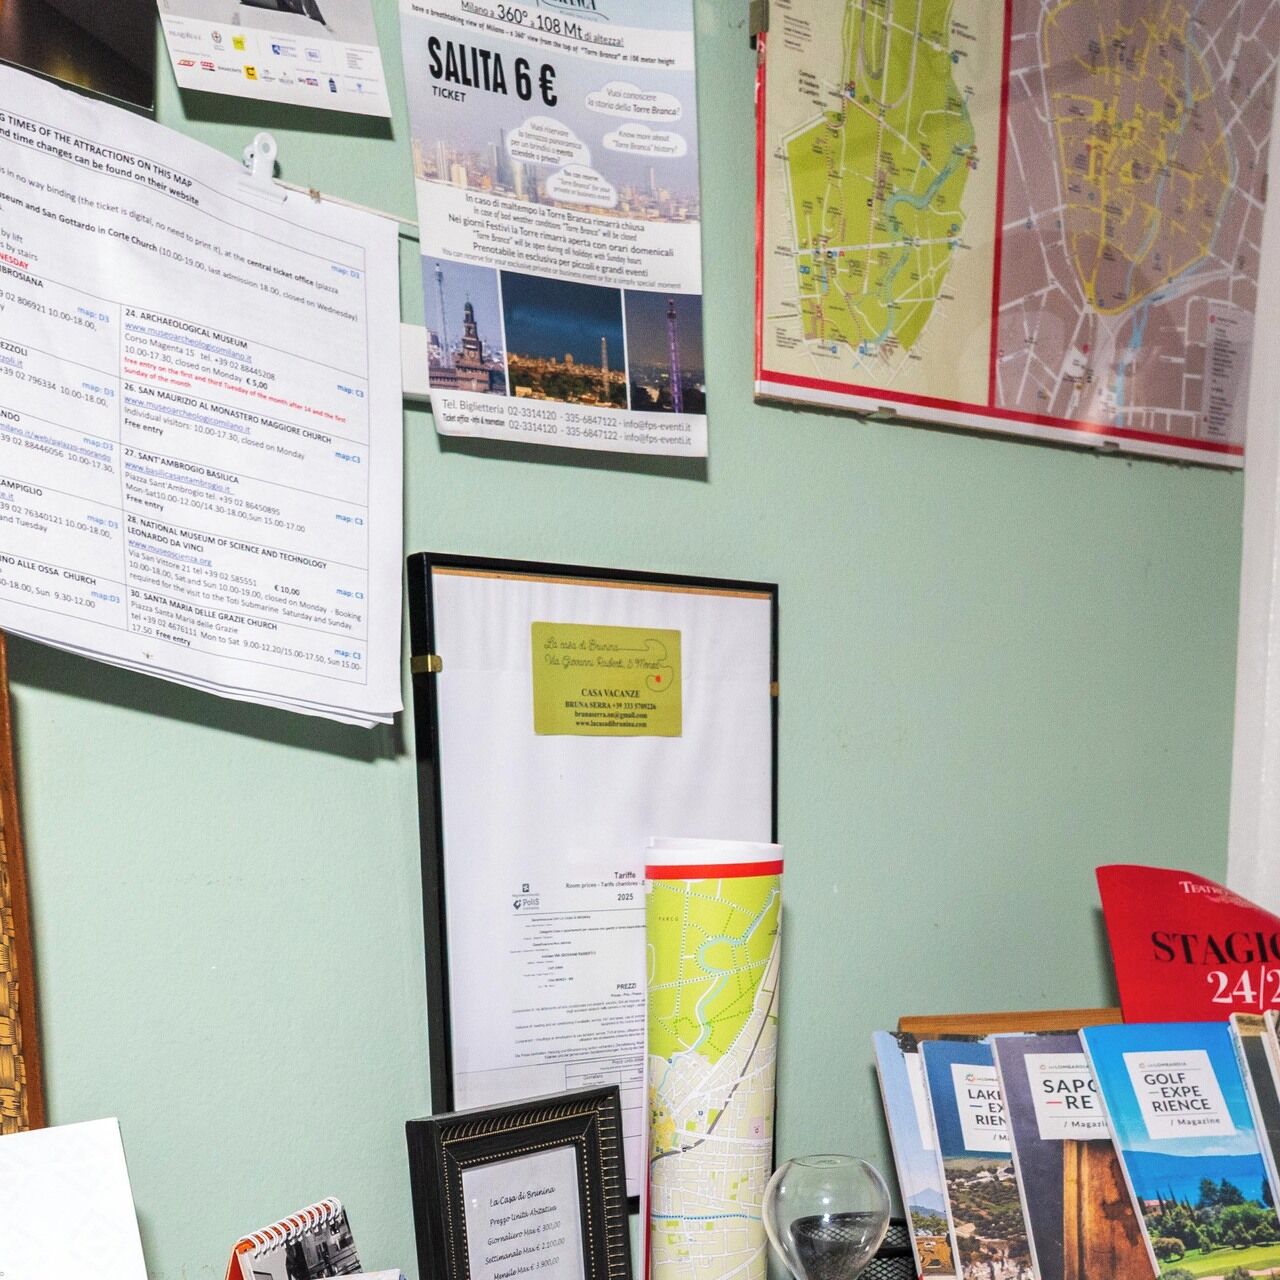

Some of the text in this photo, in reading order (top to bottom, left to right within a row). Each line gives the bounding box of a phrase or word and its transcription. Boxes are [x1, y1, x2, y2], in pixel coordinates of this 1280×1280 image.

[460, 2, 489, 16] Milano
[497, 5, 528, 24] 360°
[537, 15, 561, 33] 108
[563, 21, 583, 40] Mt
[427, 36, 508, 95] SALITA
[514, 57, 532, 101] 6
[539, 64, 557, 107] €
[432, 86, 466, 102] TICKET
[125, 309, 248, 349] 24. ARCHAEOLOGICAL MUSEUM
[443, 399, 691, 432] Tel. Biglietteria 02-3314120 335-6847122 info@fps-eventi.it
[581, 688, 640, 698] CASA VACANZE
[617, 893, 633, 901] 2025
[617, 982, 636, 990] PREZZI
[1144, 1073, 1186, 1086] GOLF
[1162, 1086, 1202, 1098] EXPE
[1066, 1095, 1093, 1110] RE
[1152, 1099, 1211, 1113] RIENCE
